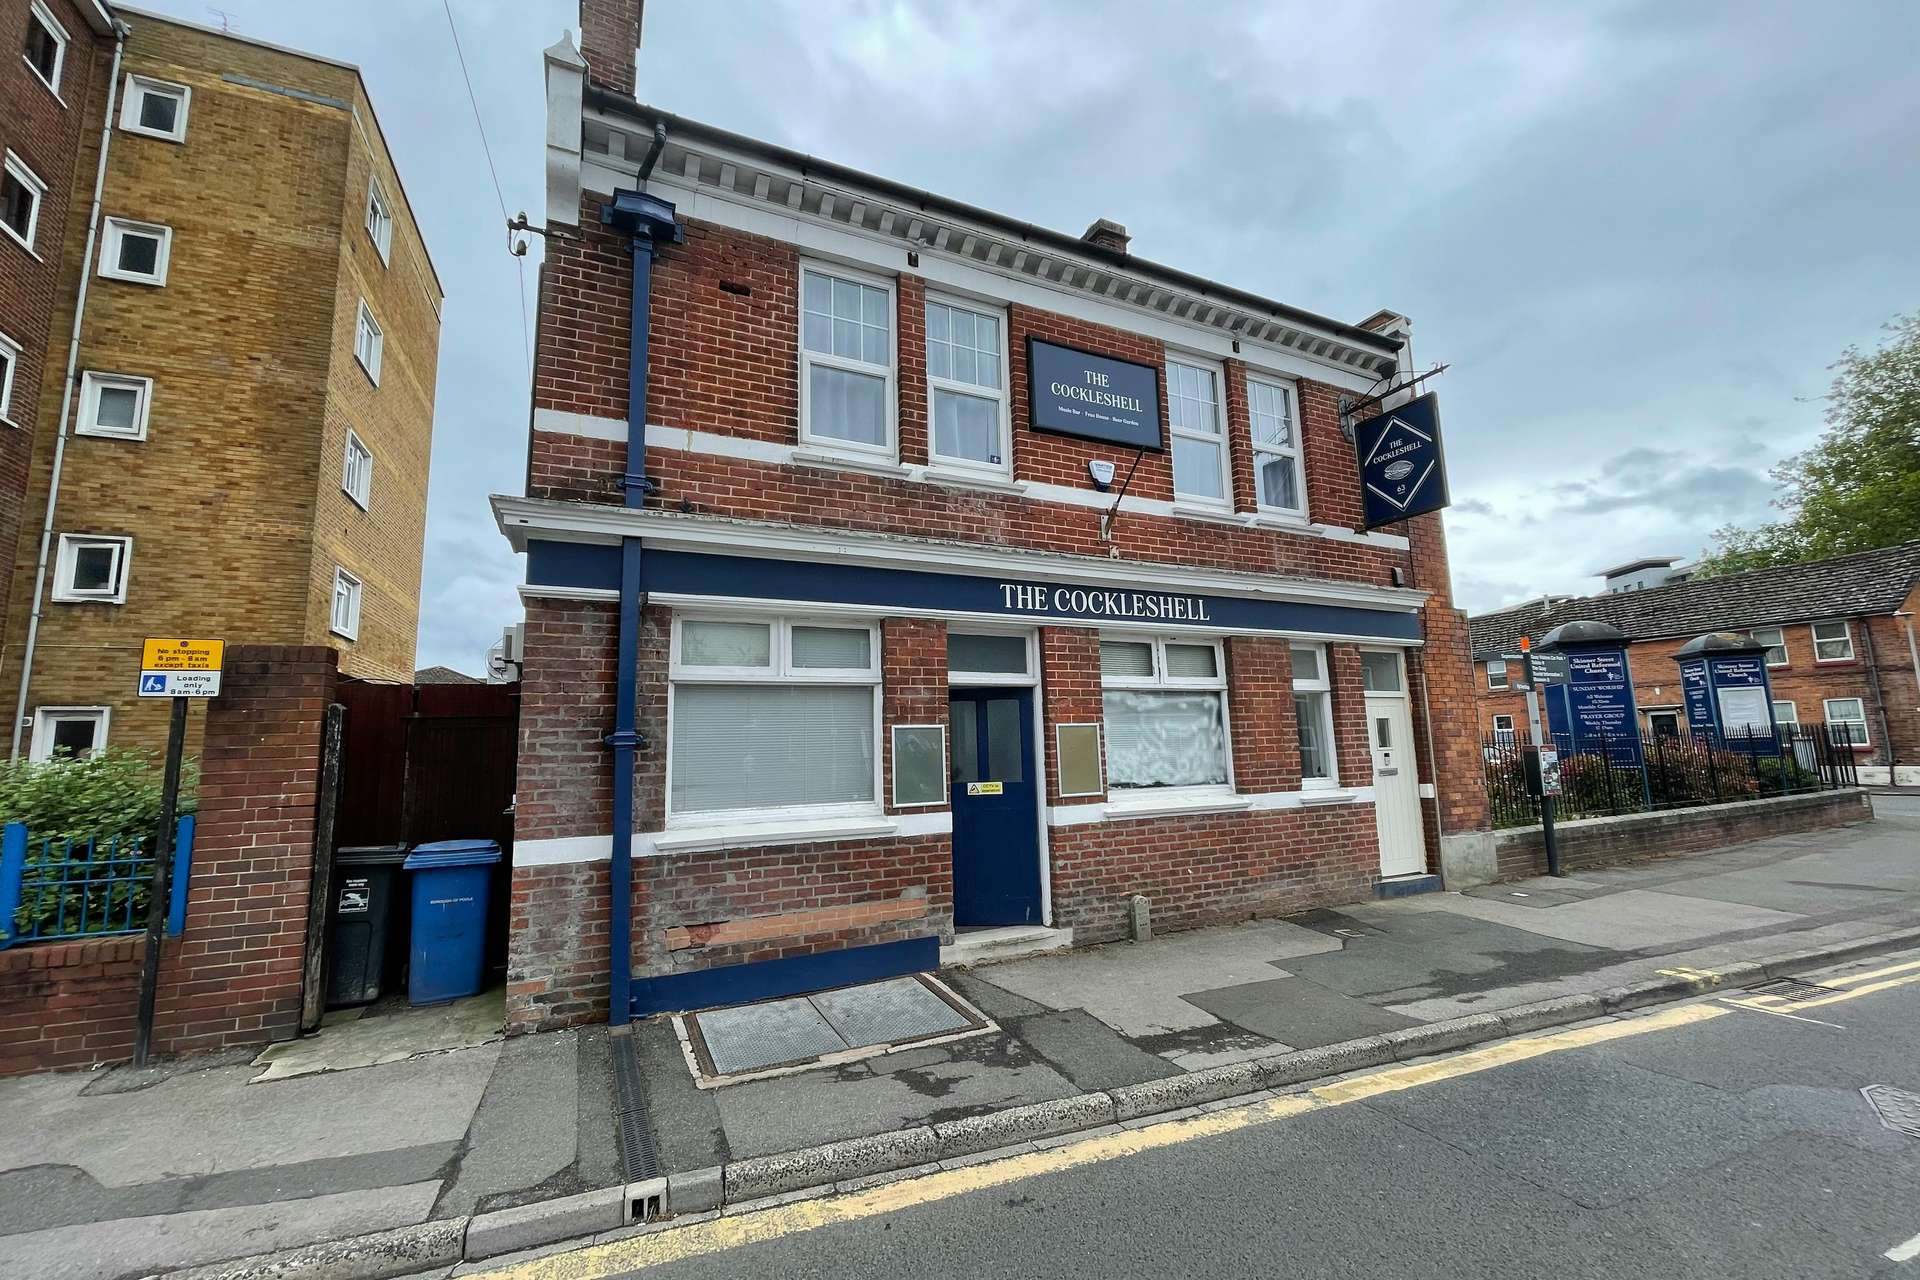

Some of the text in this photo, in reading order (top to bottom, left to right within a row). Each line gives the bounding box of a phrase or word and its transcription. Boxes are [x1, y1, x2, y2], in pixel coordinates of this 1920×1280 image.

[1084, 370, 1110, 388] THE
[1051, 382, 1143, 413] COCKLESHELL
[1374, 441, 1422, 465] COCKLESHELL
[1390, 439, 1403, 450] THE
[1000, 583, 1210, 621] THE COCKLESHELL
